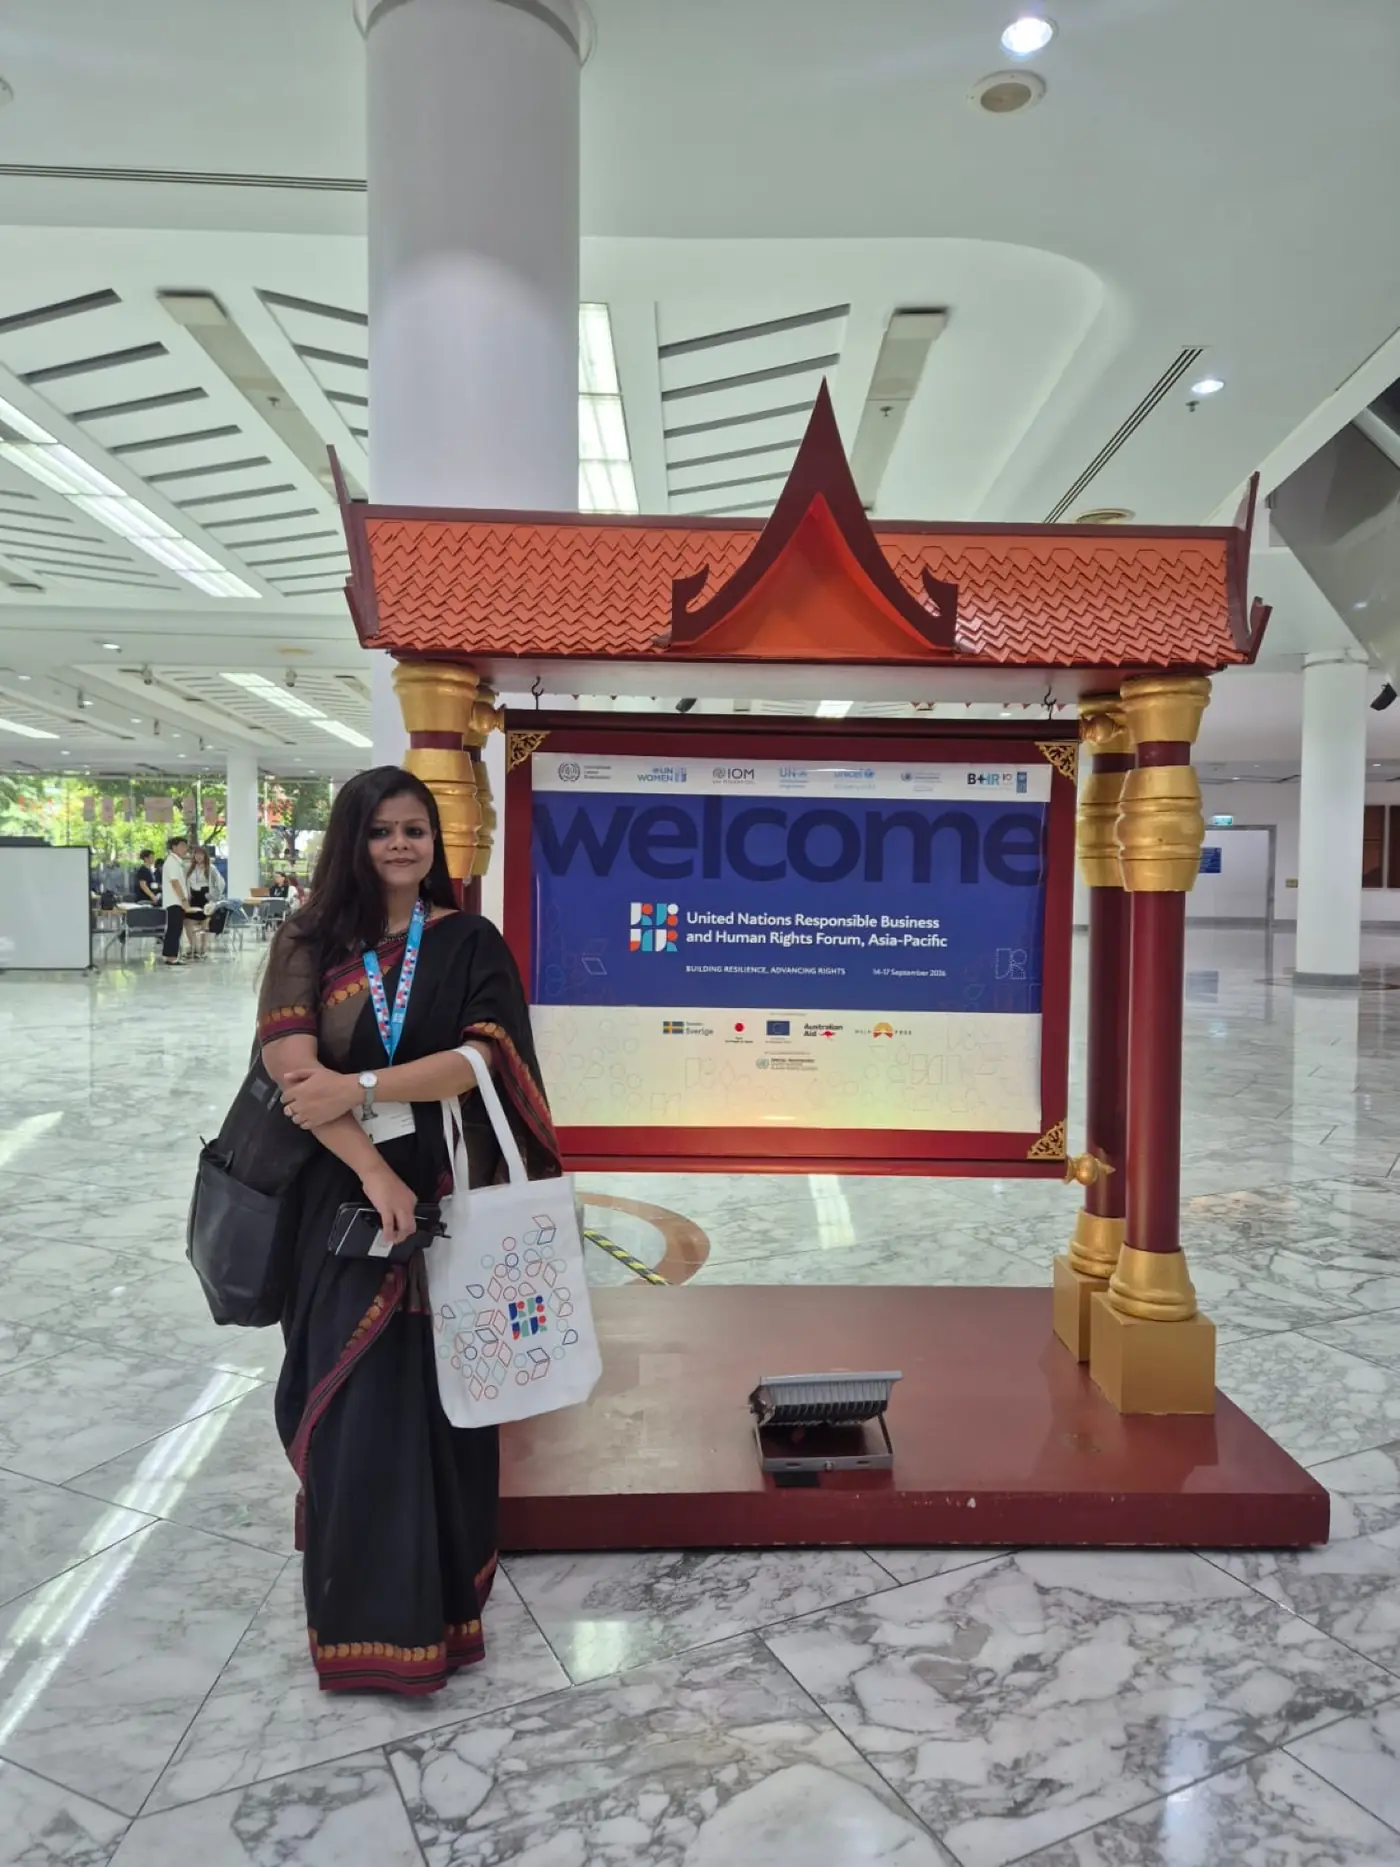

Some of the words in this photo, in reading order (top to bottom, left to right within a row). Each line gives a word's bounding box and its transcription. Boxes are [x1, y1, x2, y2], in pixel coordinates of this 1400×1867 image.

[728, 768, 755, 778] IOM
[532, 796, 1046, 886] welcome
[686, 911, 734, 925] United
[737, 913, 792, 926] Nations
[795, 914, 877, 929] Responsible
[881, 915, 939, 929] Business
[686, 930, 712, 943] and
[715, 931, 766, 944] Human
[770, 931, 813, 947] Rights
[816, 933, 865, 947] Forum,
[868, 934, 948, 948] Asia-Pacific
[686, 965, 722, 973] BUILDING
[770, 966, 816, 975] ADVANCING
[818, 967, 846, 976] RIGHTS
[891, 968, 929, 978] September
[686, 1027, 714, 1036] Sverige
[804, 1023, 843, 1031] Australian
